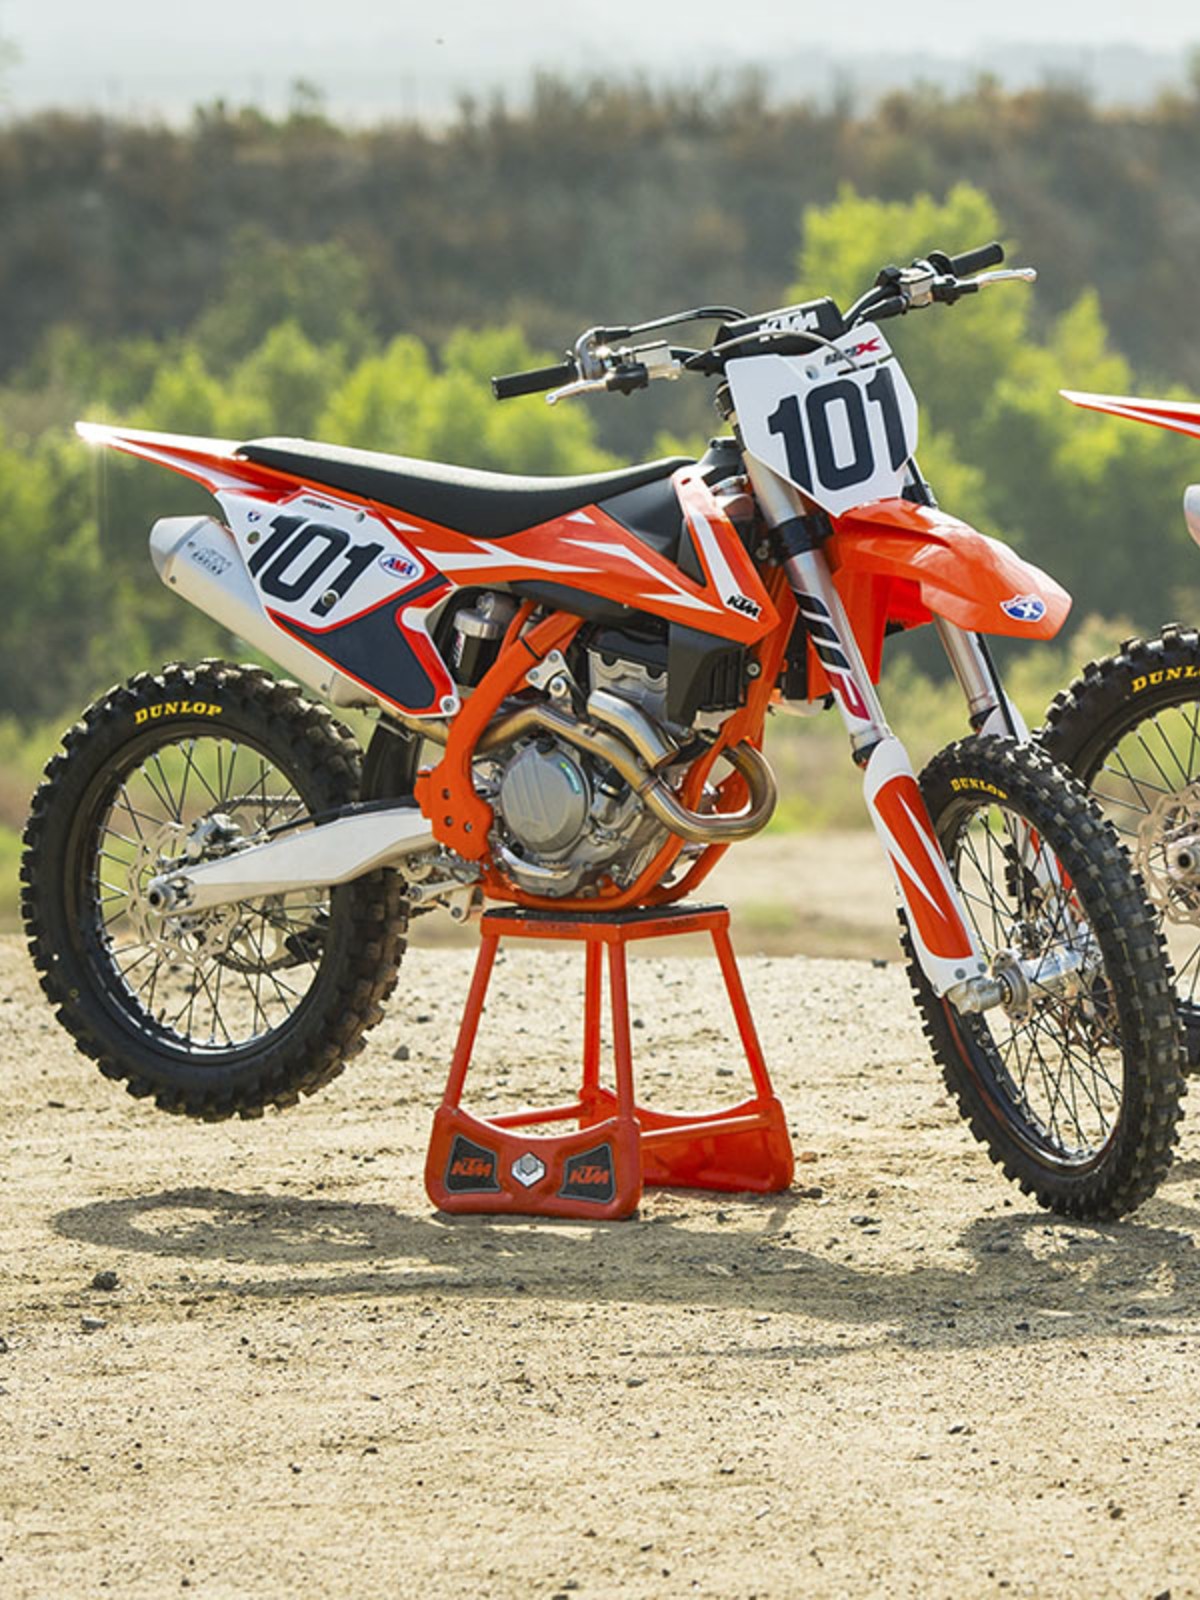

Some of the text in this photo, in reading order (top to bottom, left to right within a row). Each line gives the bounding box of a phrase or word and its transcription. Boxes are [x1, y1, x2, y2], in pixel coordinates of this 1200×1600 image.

[758, 310, 820, 342] KTM
[768, 366, 907, 495] 101
[248, 515, 384, 617] 101
[727, 595, 761, 617] KTM
[134, 701, 223, 725] DUNLOP
[949, 777, 1008, 800] DUNLOP
[451, 1157, 493, 1178] KTM
[568, 1165, 609, 1185] KTM
